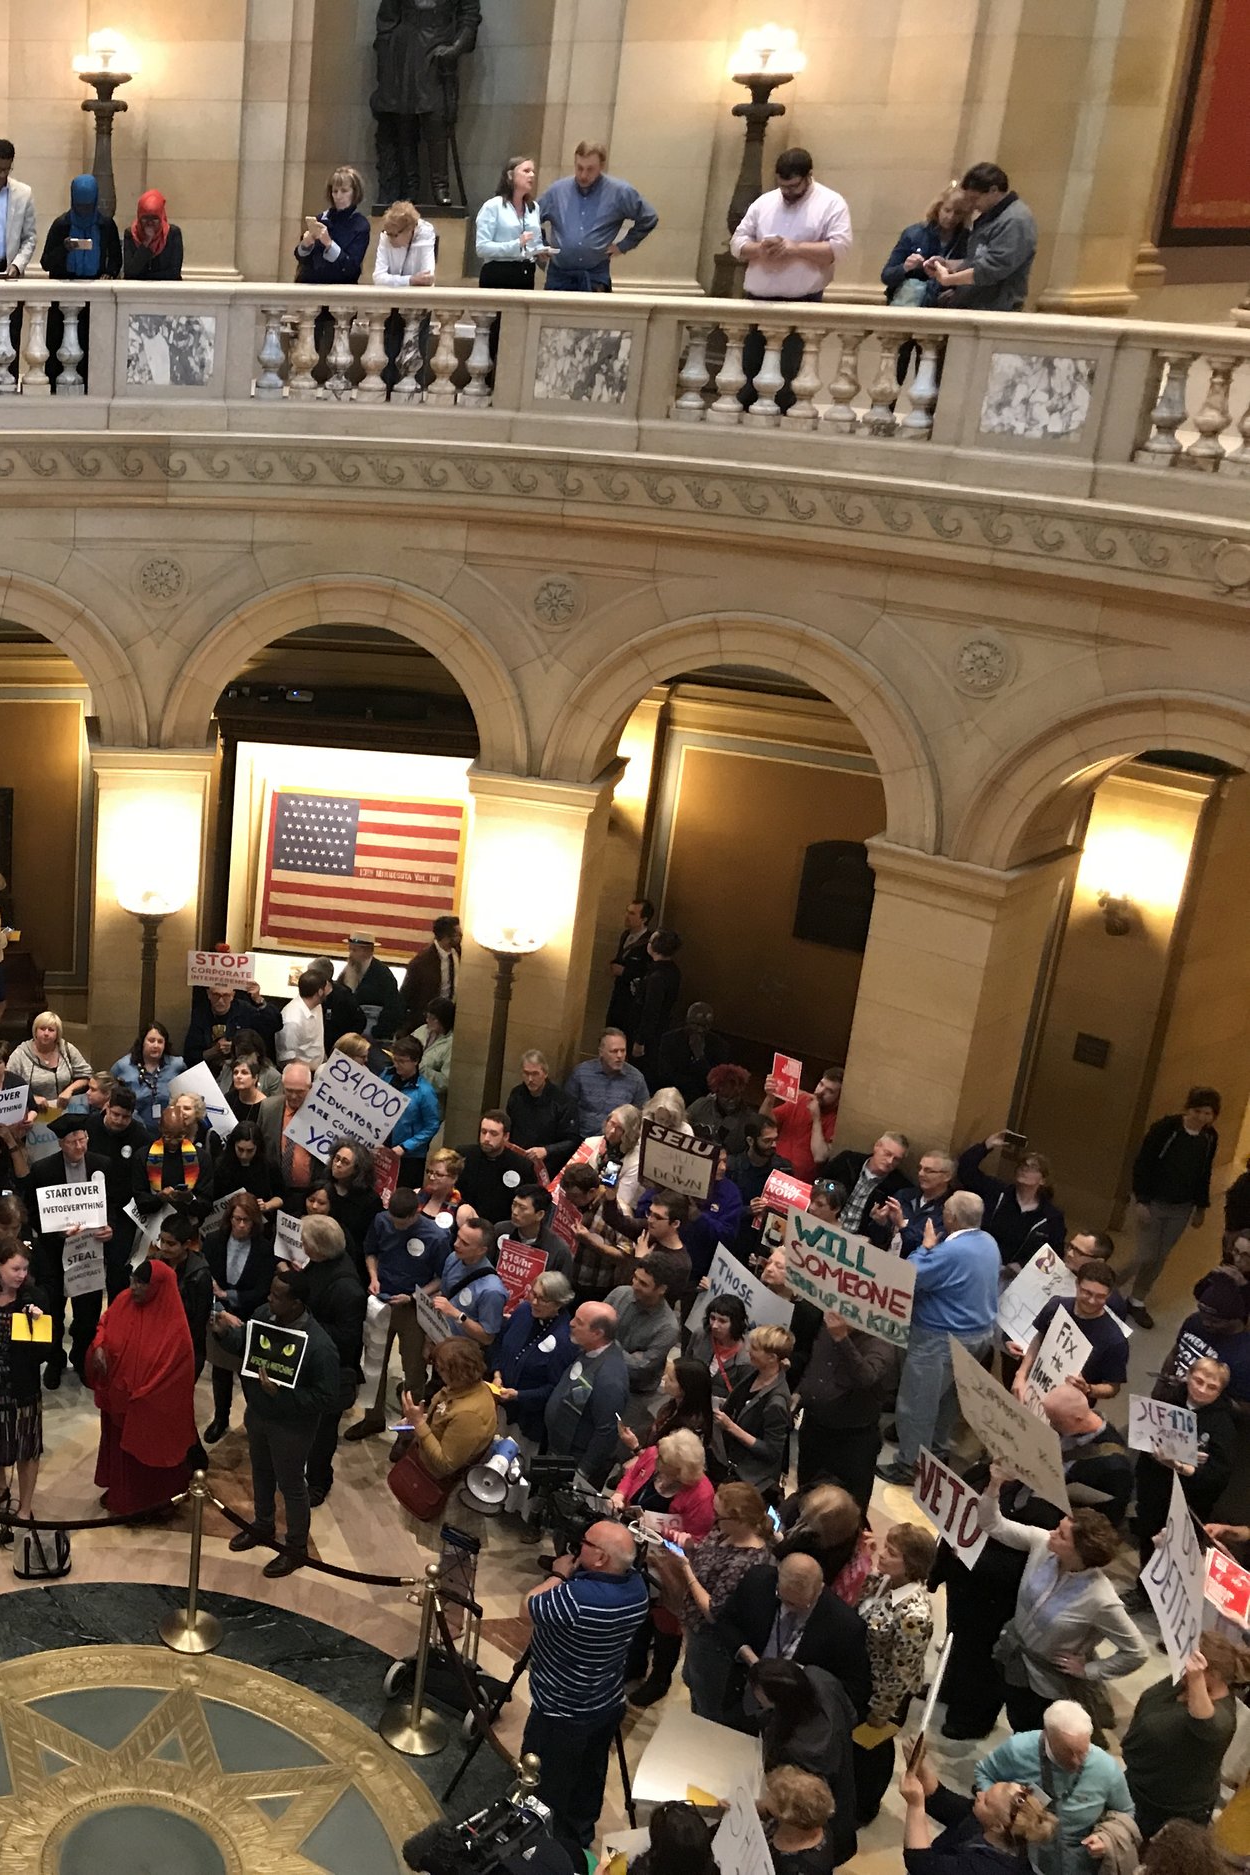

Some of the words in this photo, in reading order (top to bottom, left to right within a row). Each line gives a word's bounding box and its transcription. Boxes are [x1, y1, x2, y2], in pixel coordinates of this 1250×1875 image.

[191, 967, 252, 979] CORPORATE
[196, 953, 248, 968] STOP
[191, 975, 249, 986] INTERFERENC
[329, 1059, 401, 1117] 84,000
[308, 1103, 329, 1121] ARE
[332, 1119, 376, 1149] COUNTIN
[316, 1082, 381, 1140] EDUCATORS
[306, 1126, 333, 1155] YO
[649, 1125, 715, 1156] SEIU
[45, 1187, 72, 1199] START
[74, 1185, 99, 1196] OVER
[42, 1201, 104, 1214] #VETOEVERYTHING
[67, 1250, 97, 1266] STEAL
[794, 1215, 876, 1278] WILL
[500, 1261, 531, 1279] NOW!
[717, 1257, 754, 1308] THOSE
[789, 1240, 912, 1319] SOMEONE
[919, 1452, 982, 1547] VETO
